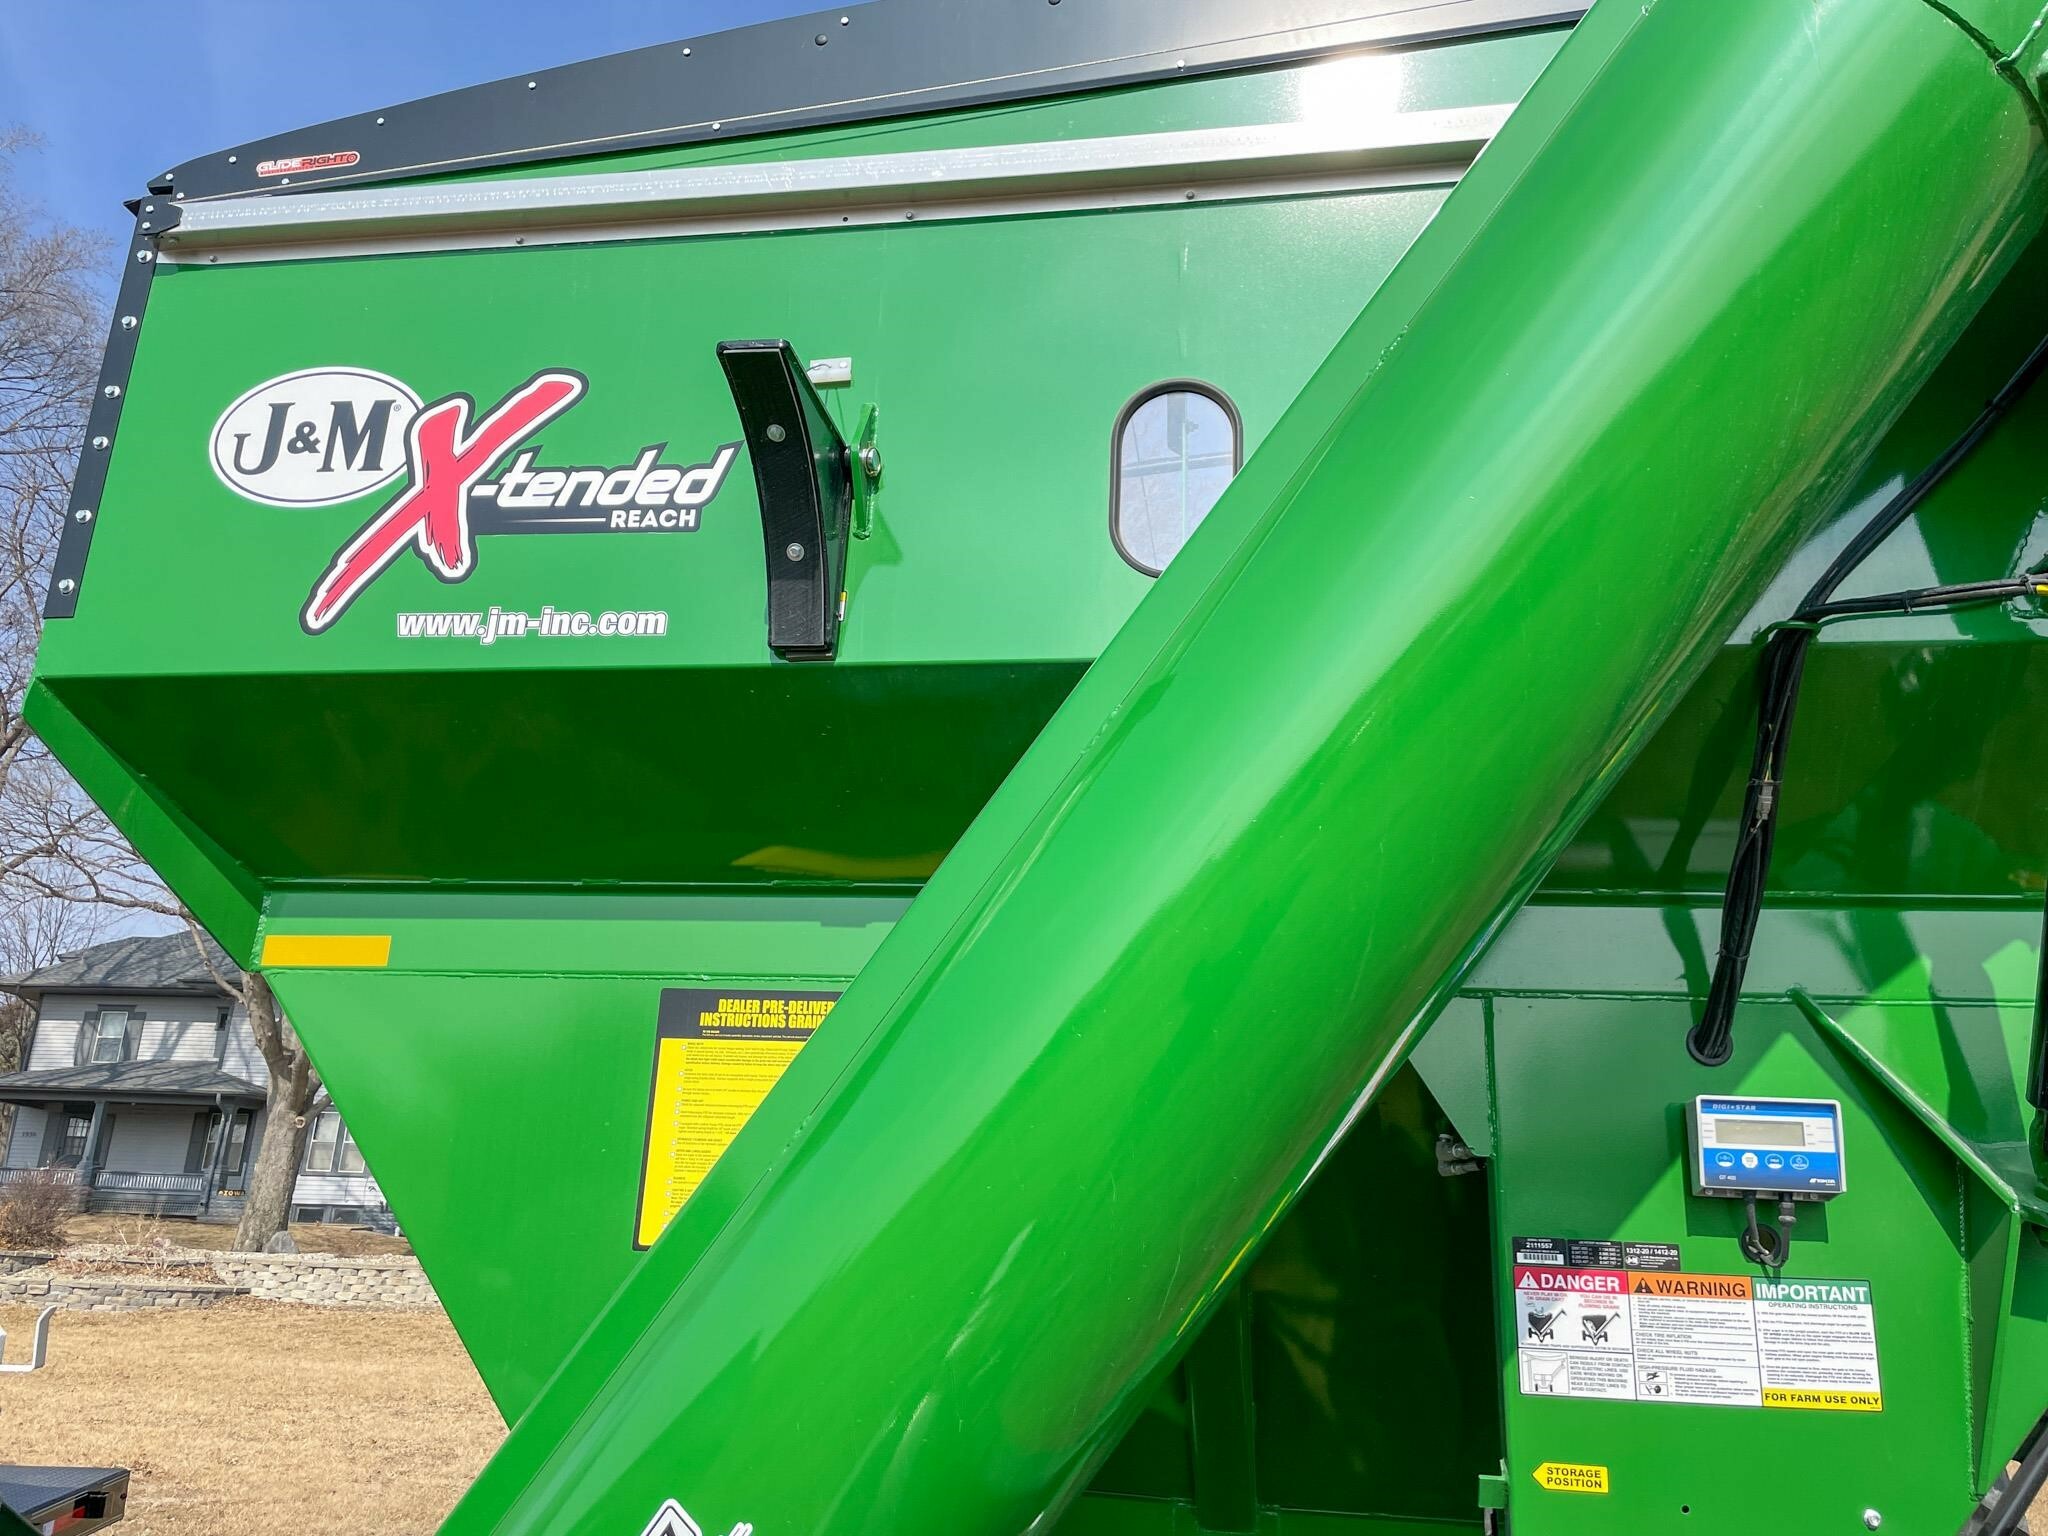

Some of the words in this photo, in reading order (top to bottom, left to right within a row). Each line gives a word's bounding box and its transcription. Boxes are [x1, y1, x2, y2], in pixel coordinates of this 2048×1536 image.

[234, 399, 396, 474] J&M
[610, 509, 696, 528] REACH
[396, 606, 669, 645] www.jm-inc.com
[718, 998, 760, 1013] DEALER
[762, 999, 837, 1015] PRE-DELIVER
[699, 1012, 786, 1028] INSTRUCTIONS
[1540, 1273, 1620, 1292] DANGER
[1656, 1280, 1746, 1297] WARNING
[1755, 1283, 1868, 1302] IMPORTANT
[1808, 1303, 1858, 1311] INSTRUCTIONS
[1765, 1392, 1787, 1402] FOR
[1790, 1394, 1821, 1403] FARM
[1824, 1395, 1847, 1404] USE
[1850, 1396, 1879, 1405] ONLY
[1547, 1466, 1601, 1478] STORAGE
[1547, 1477, 1602, 1488] POSITION
